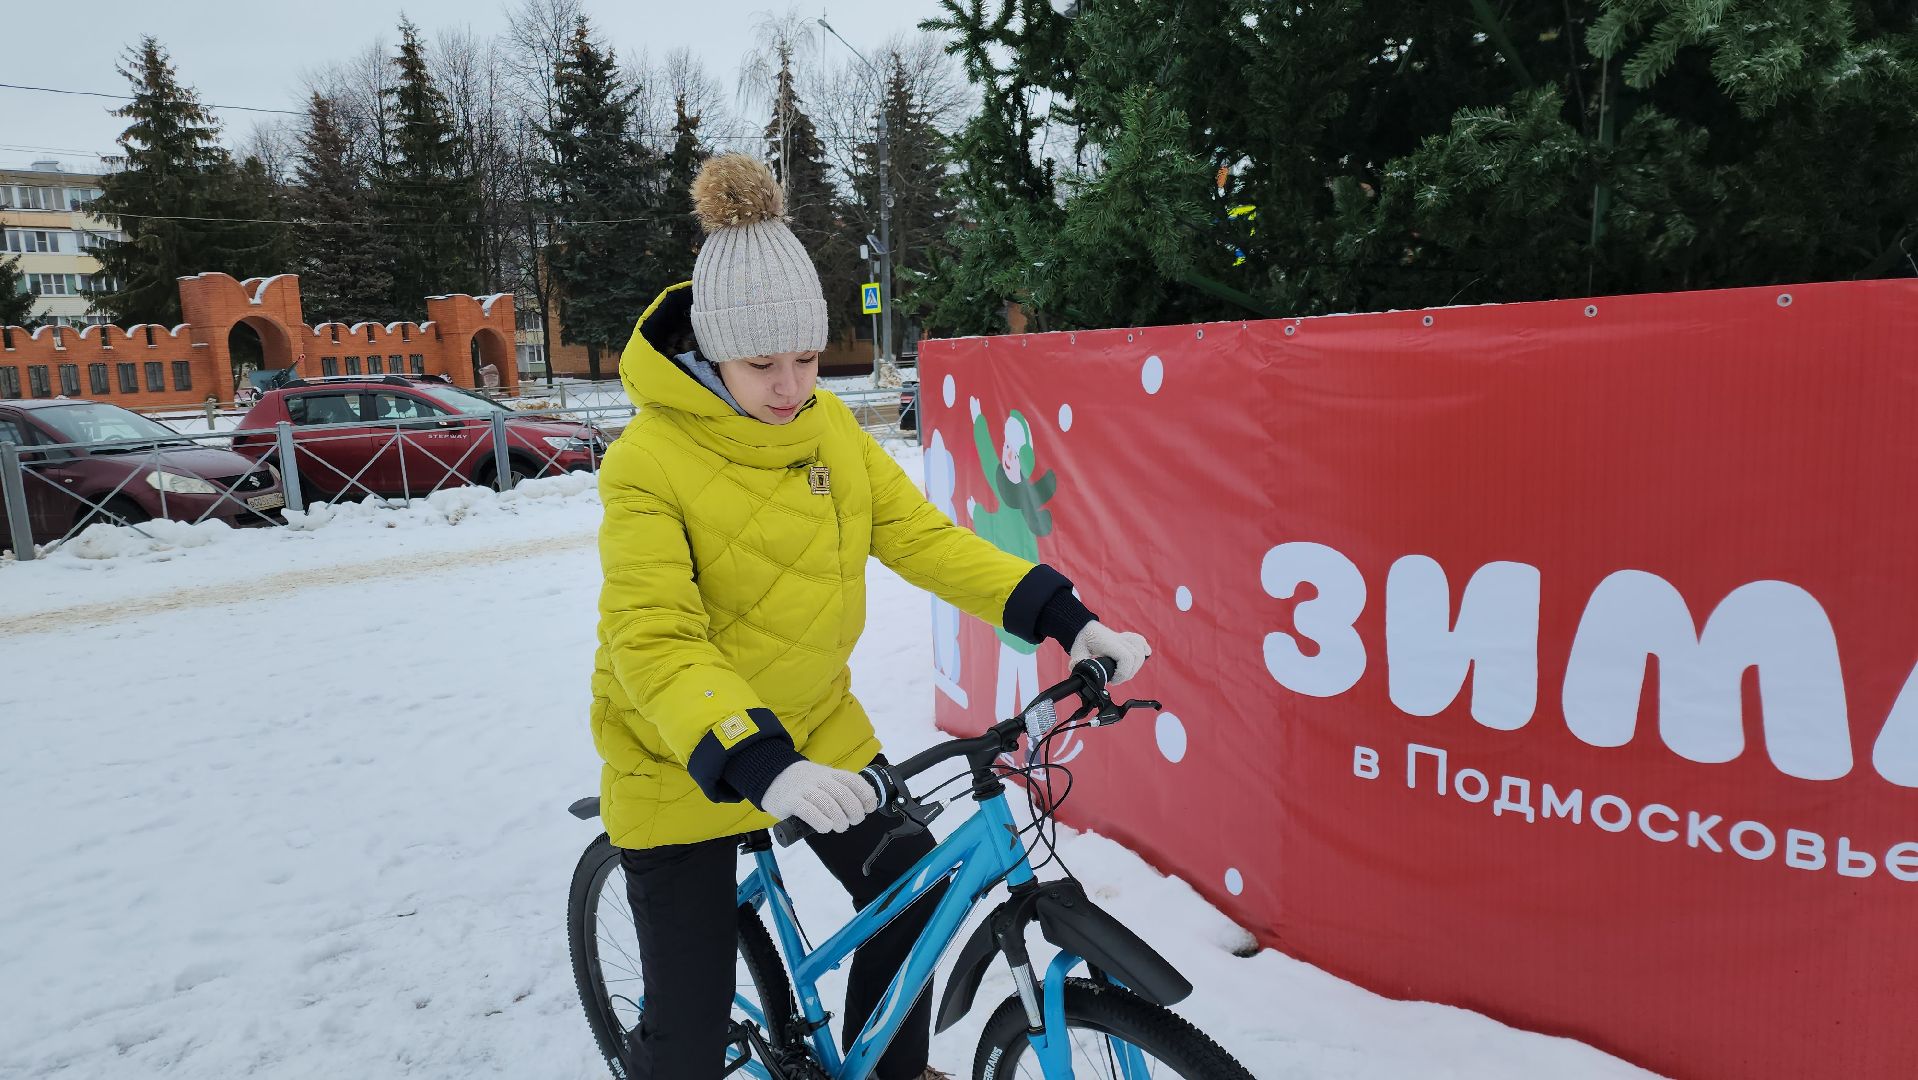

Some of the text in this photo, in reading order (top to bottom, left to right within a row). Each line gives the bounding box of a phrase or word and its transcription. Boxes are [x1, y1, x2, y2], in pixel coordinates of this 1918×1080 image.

[1260, 541, 1918, 788] ЗИМ
[1353, 743, 1918, 882] в Подмосковье
[610, 1056, 627, 1080] AINS
